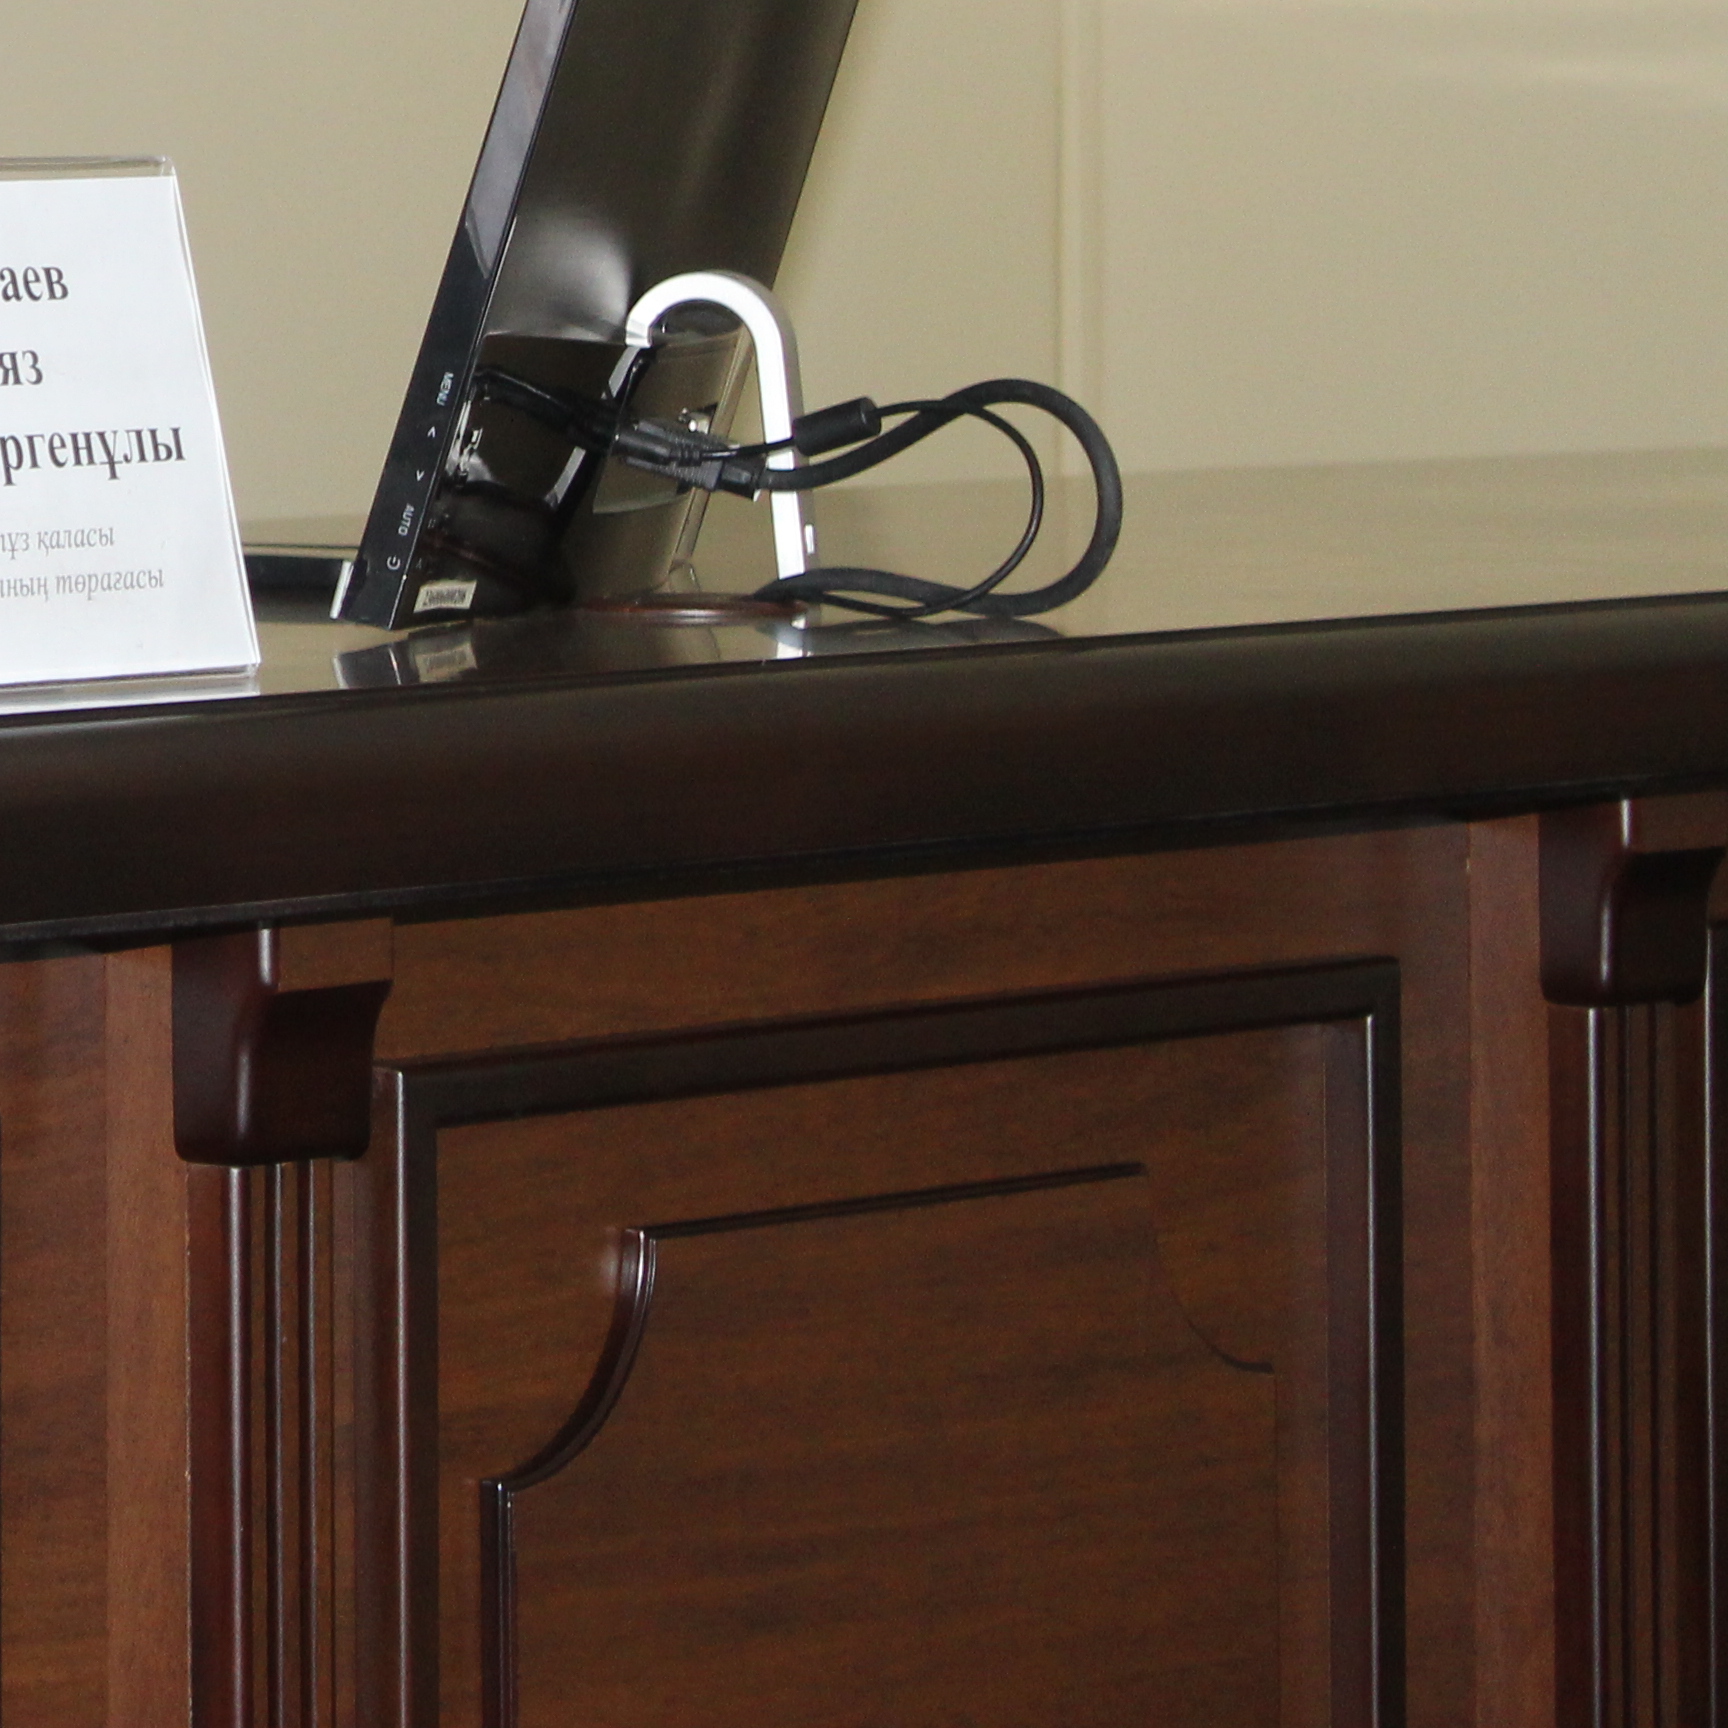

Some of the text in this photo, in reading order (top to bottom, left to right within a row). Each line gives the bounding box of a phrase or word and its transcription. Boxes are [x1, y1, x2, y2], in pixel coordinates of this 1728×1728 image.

[437, 372, 454, 406] MENU
[398, 503, 415, 536] AUTO
[36, 526, 115, 556] қаласы
[54, 568, 165, 602] төрағасы
